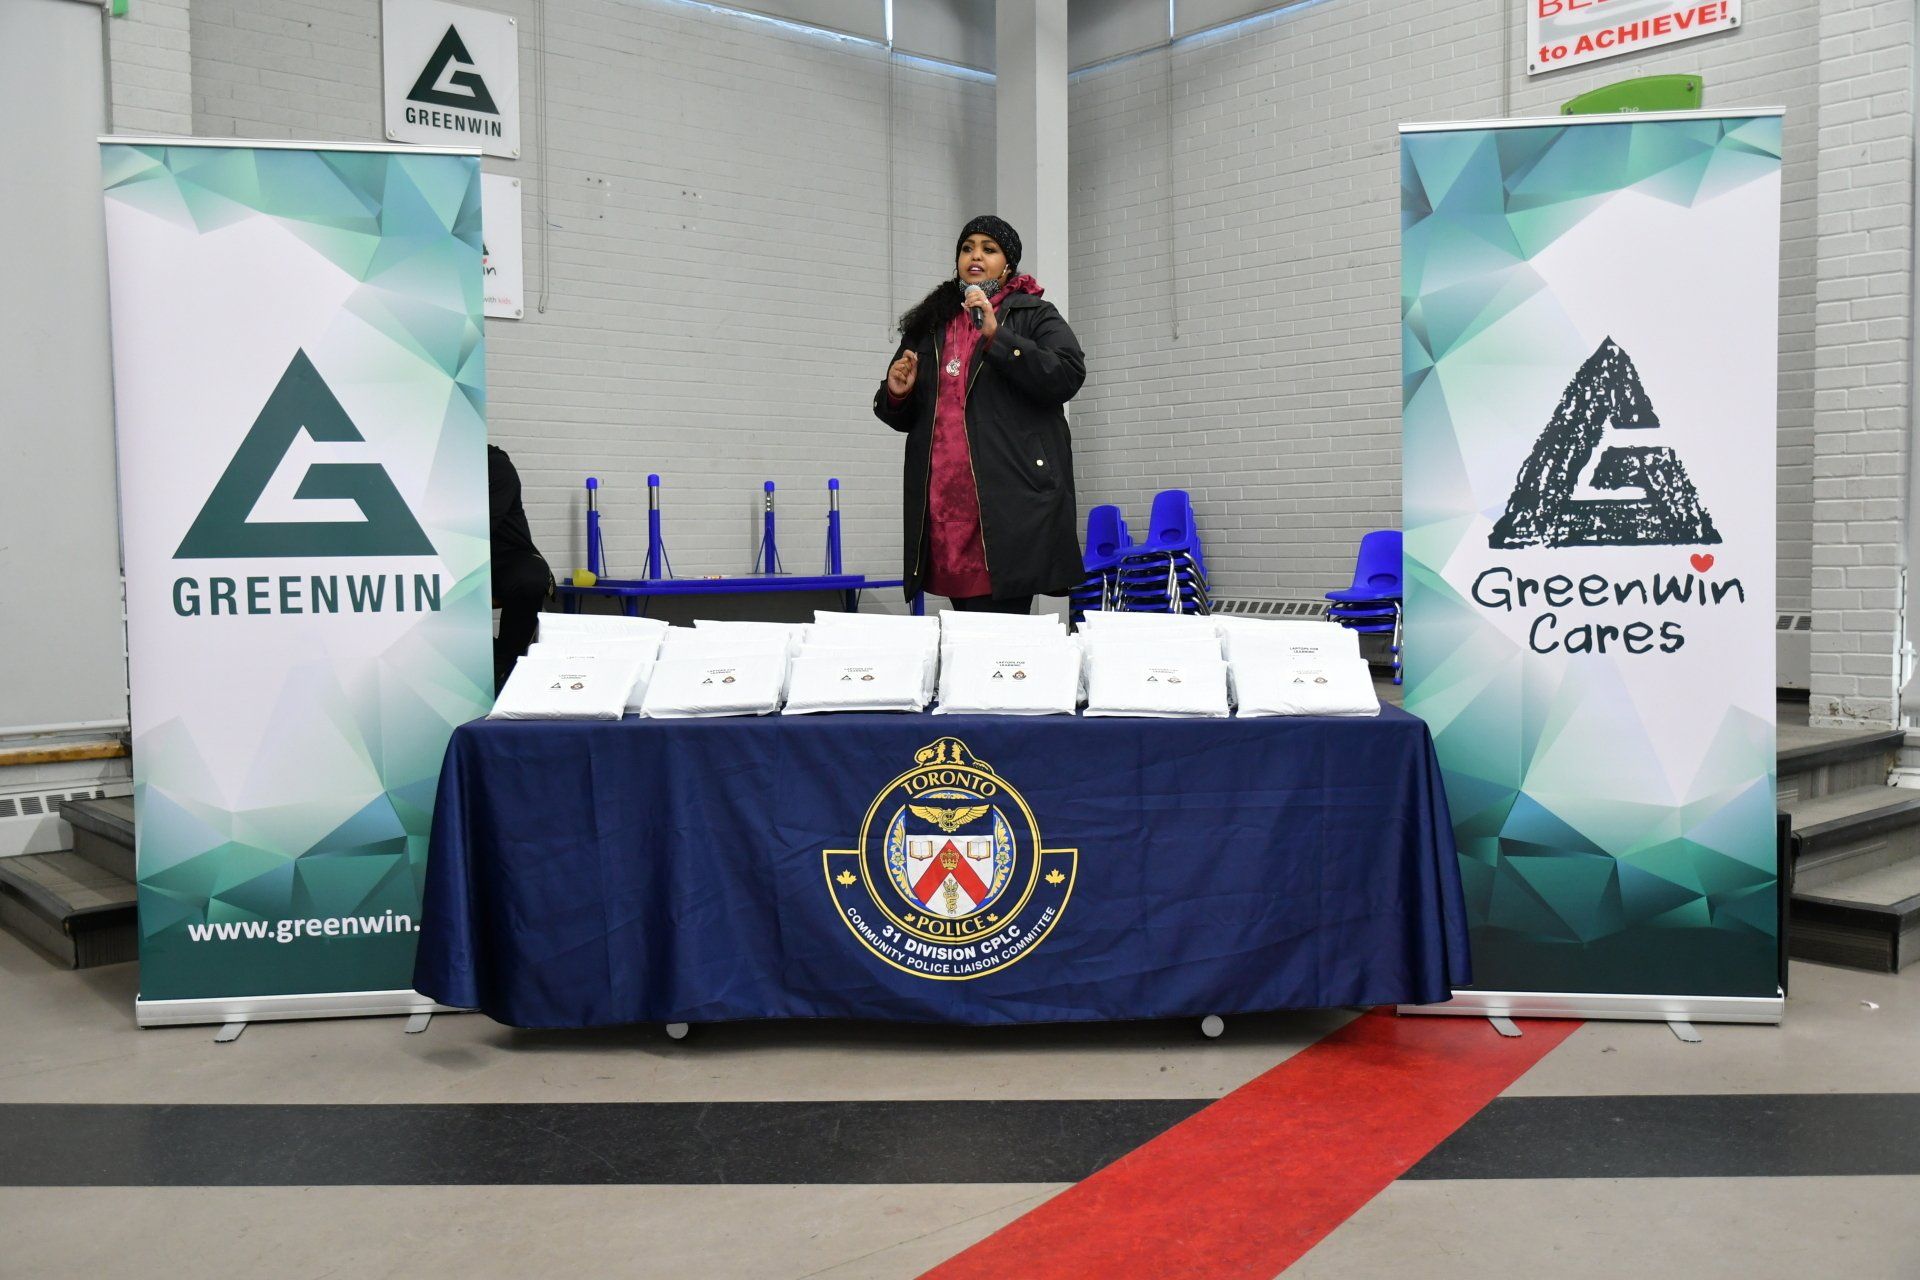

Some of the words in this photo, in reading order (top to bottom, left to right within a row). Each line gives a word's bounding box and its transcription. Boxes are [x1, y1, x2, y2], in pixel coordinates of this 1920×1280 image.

[1539, 44, 1567, 63] to
[1574, 0, 1728, 55] ACHIEVE!
[405, 107, 502, 138] GREENWIN
[172, 573, 442, 617] GREENWIN
[1471, 556, 1745, 612] Greenwin
[1529, 613, 1685, 654] Cares
[900, 771, 997, 798] TORONTO
[188, 909, 421, 943] www.greenwin.
[847, 907, 905, 962] COMMUNITY
[907, 956, 950, 974] POLICE
[953, 955, 1000, 974] LIAISON
[1002, 906, 1056, 960] COMMITTEE
[882, 924, 902, 944] 31
[904, 939, 977, 961] DIVISION
[980, 925, 1022, 954] CPLC
[916, 916, 986, 936] POLICE
